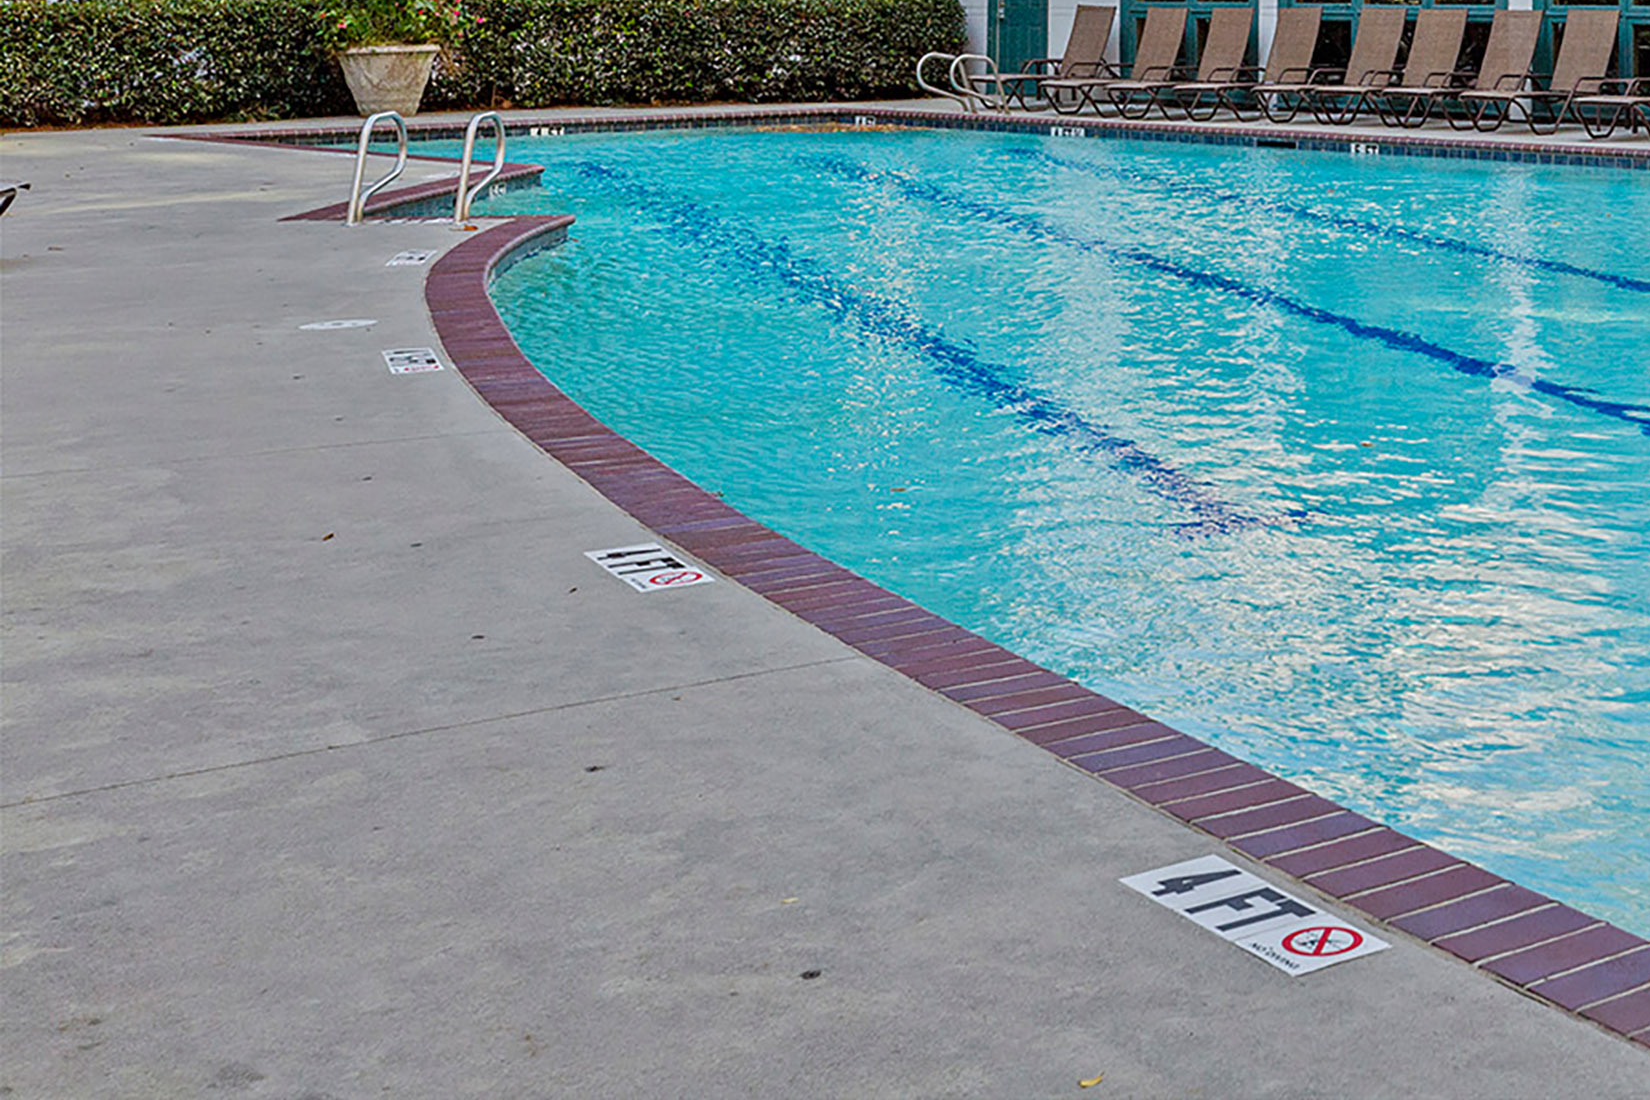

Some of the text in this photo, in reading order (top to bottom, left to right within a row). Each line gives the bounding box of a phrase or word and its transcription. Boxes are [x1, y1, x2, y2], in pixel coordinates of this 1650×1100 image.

[607, 556, 687, 576] FT
[1150, 868, 1318, 933] 4 FT
